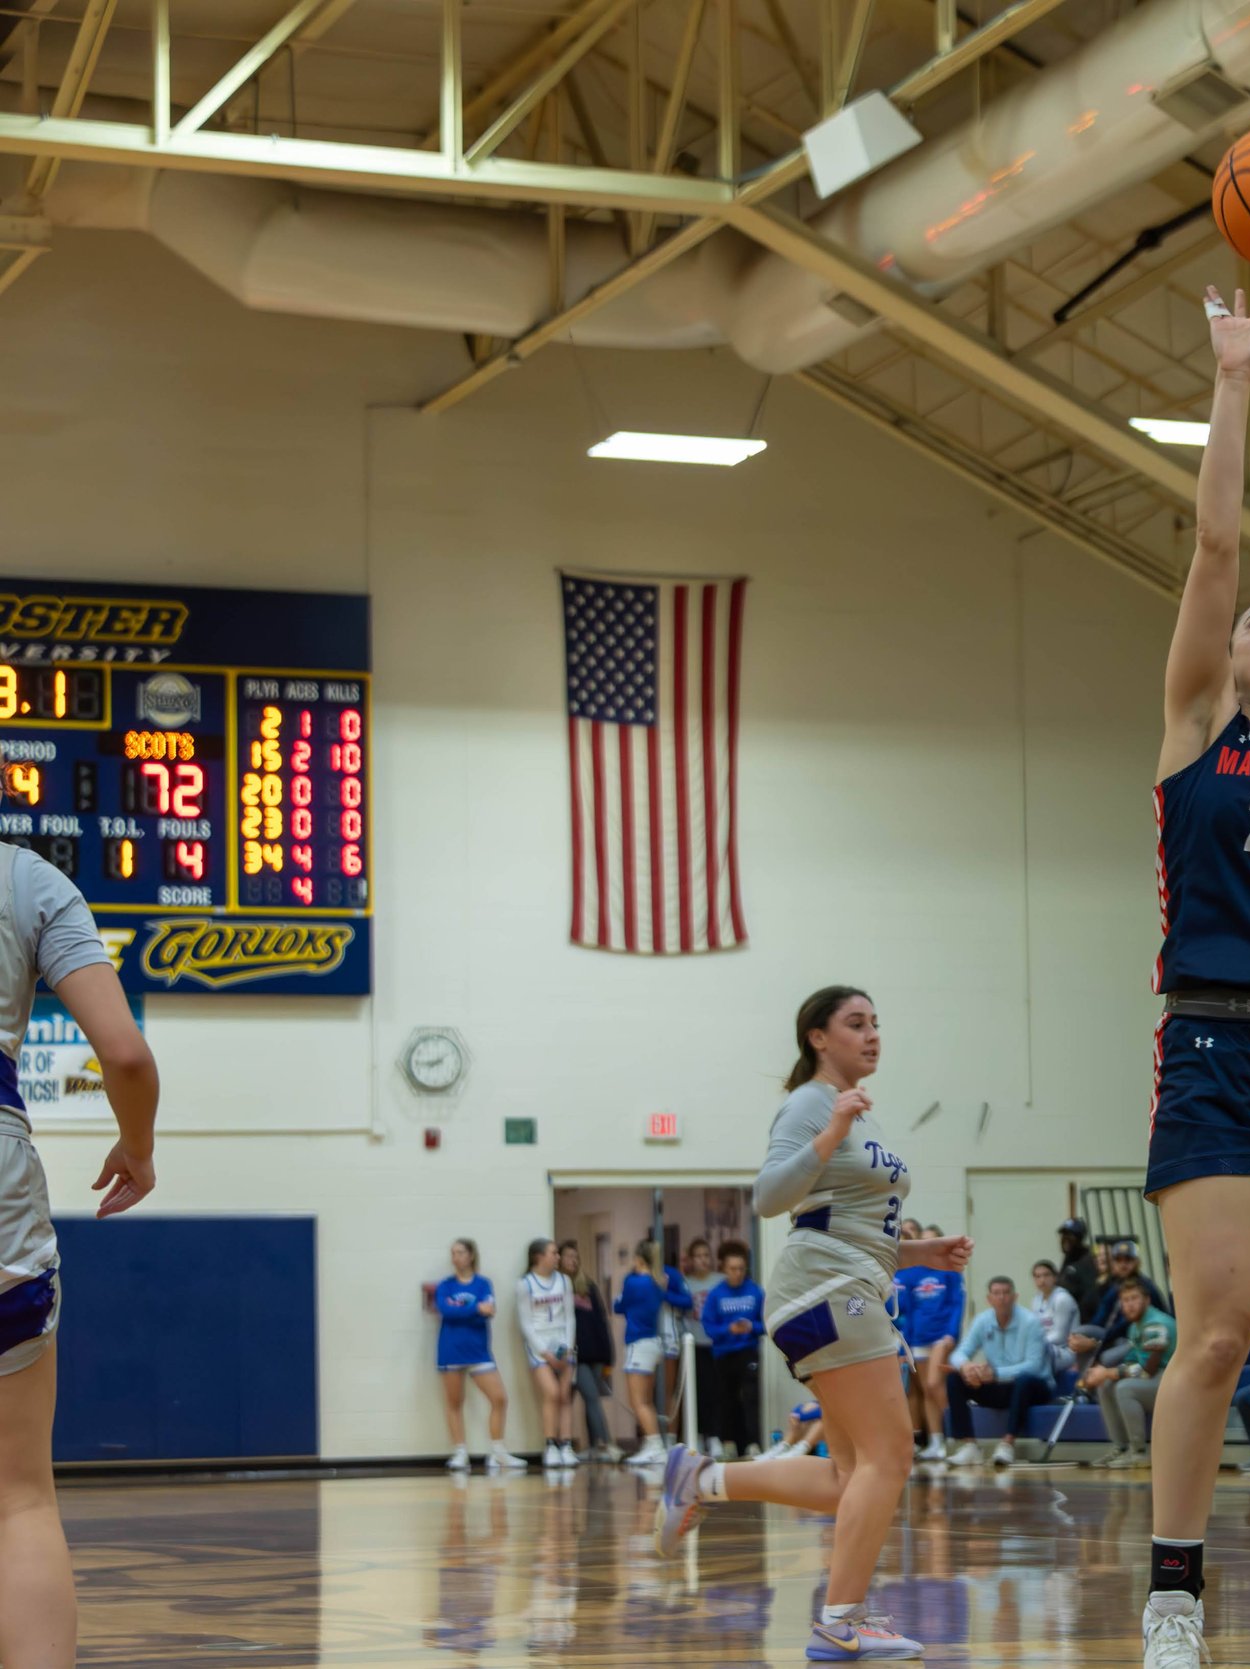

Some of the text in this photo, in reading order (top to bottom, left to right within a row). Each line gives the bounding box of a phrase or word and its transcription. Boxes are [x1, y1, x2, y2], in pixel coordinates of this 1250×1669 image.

[246, 679, 360, 702] PLYR ACES KILLS
[260, 705, 361, 742] 2 1 0
[124, 730, 195, 760] SCOTS
[250, 739, 361, 775] 15 2 10
[12, 763, 204, 817] 4 72
[241, 772, 361, 809] 20 0 0
[40, 815, 84, 836] FOUL
[157, 818, 212, 840] FOULS
[241, 806, 362, 842] 23 0 0
[120, 839, 204, 880] 1 4
[243, 840, 363, 877] 34 4 6
[158, 885, 212, 906] SCORE
[291, 876, 313, 906] 4
[36, 1052, 56, 1073] OF
[650, 1113, 677, 1137] EXIT
